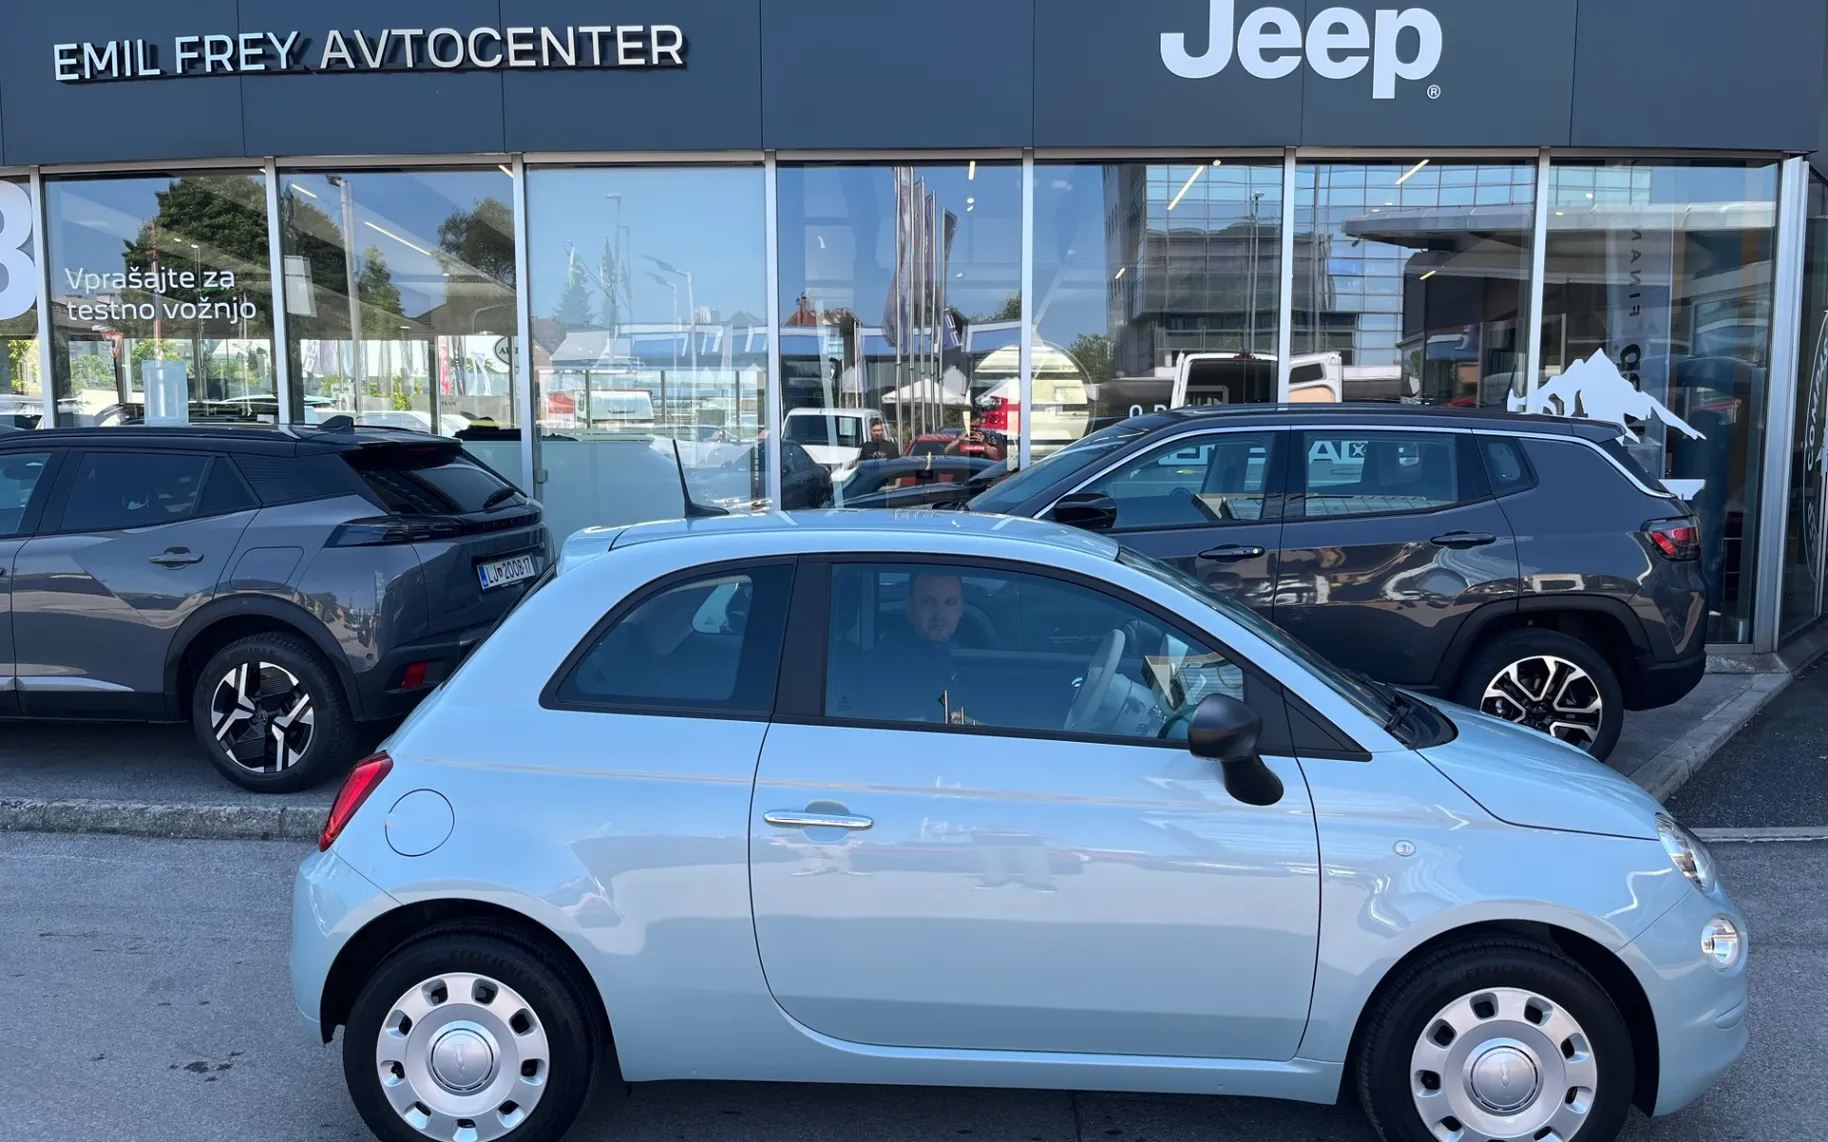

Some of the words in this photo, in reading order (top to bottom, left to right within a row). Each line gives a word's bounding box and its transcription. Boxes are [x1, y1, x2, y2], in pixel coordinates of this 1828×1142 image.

[53, 38, 160, 82] EMIL
[174, 30, 300, 75] FREY
[319, 24, 684, 70] AVTOCENTER
[1160, 0, 1442, 99] Jeep
[64, 267, 195, 294] Vprašajte
[203, 270, 235, 290] za
[66, 300, 156, 321] testno
[163, 296, 257, 326] vožnjo
